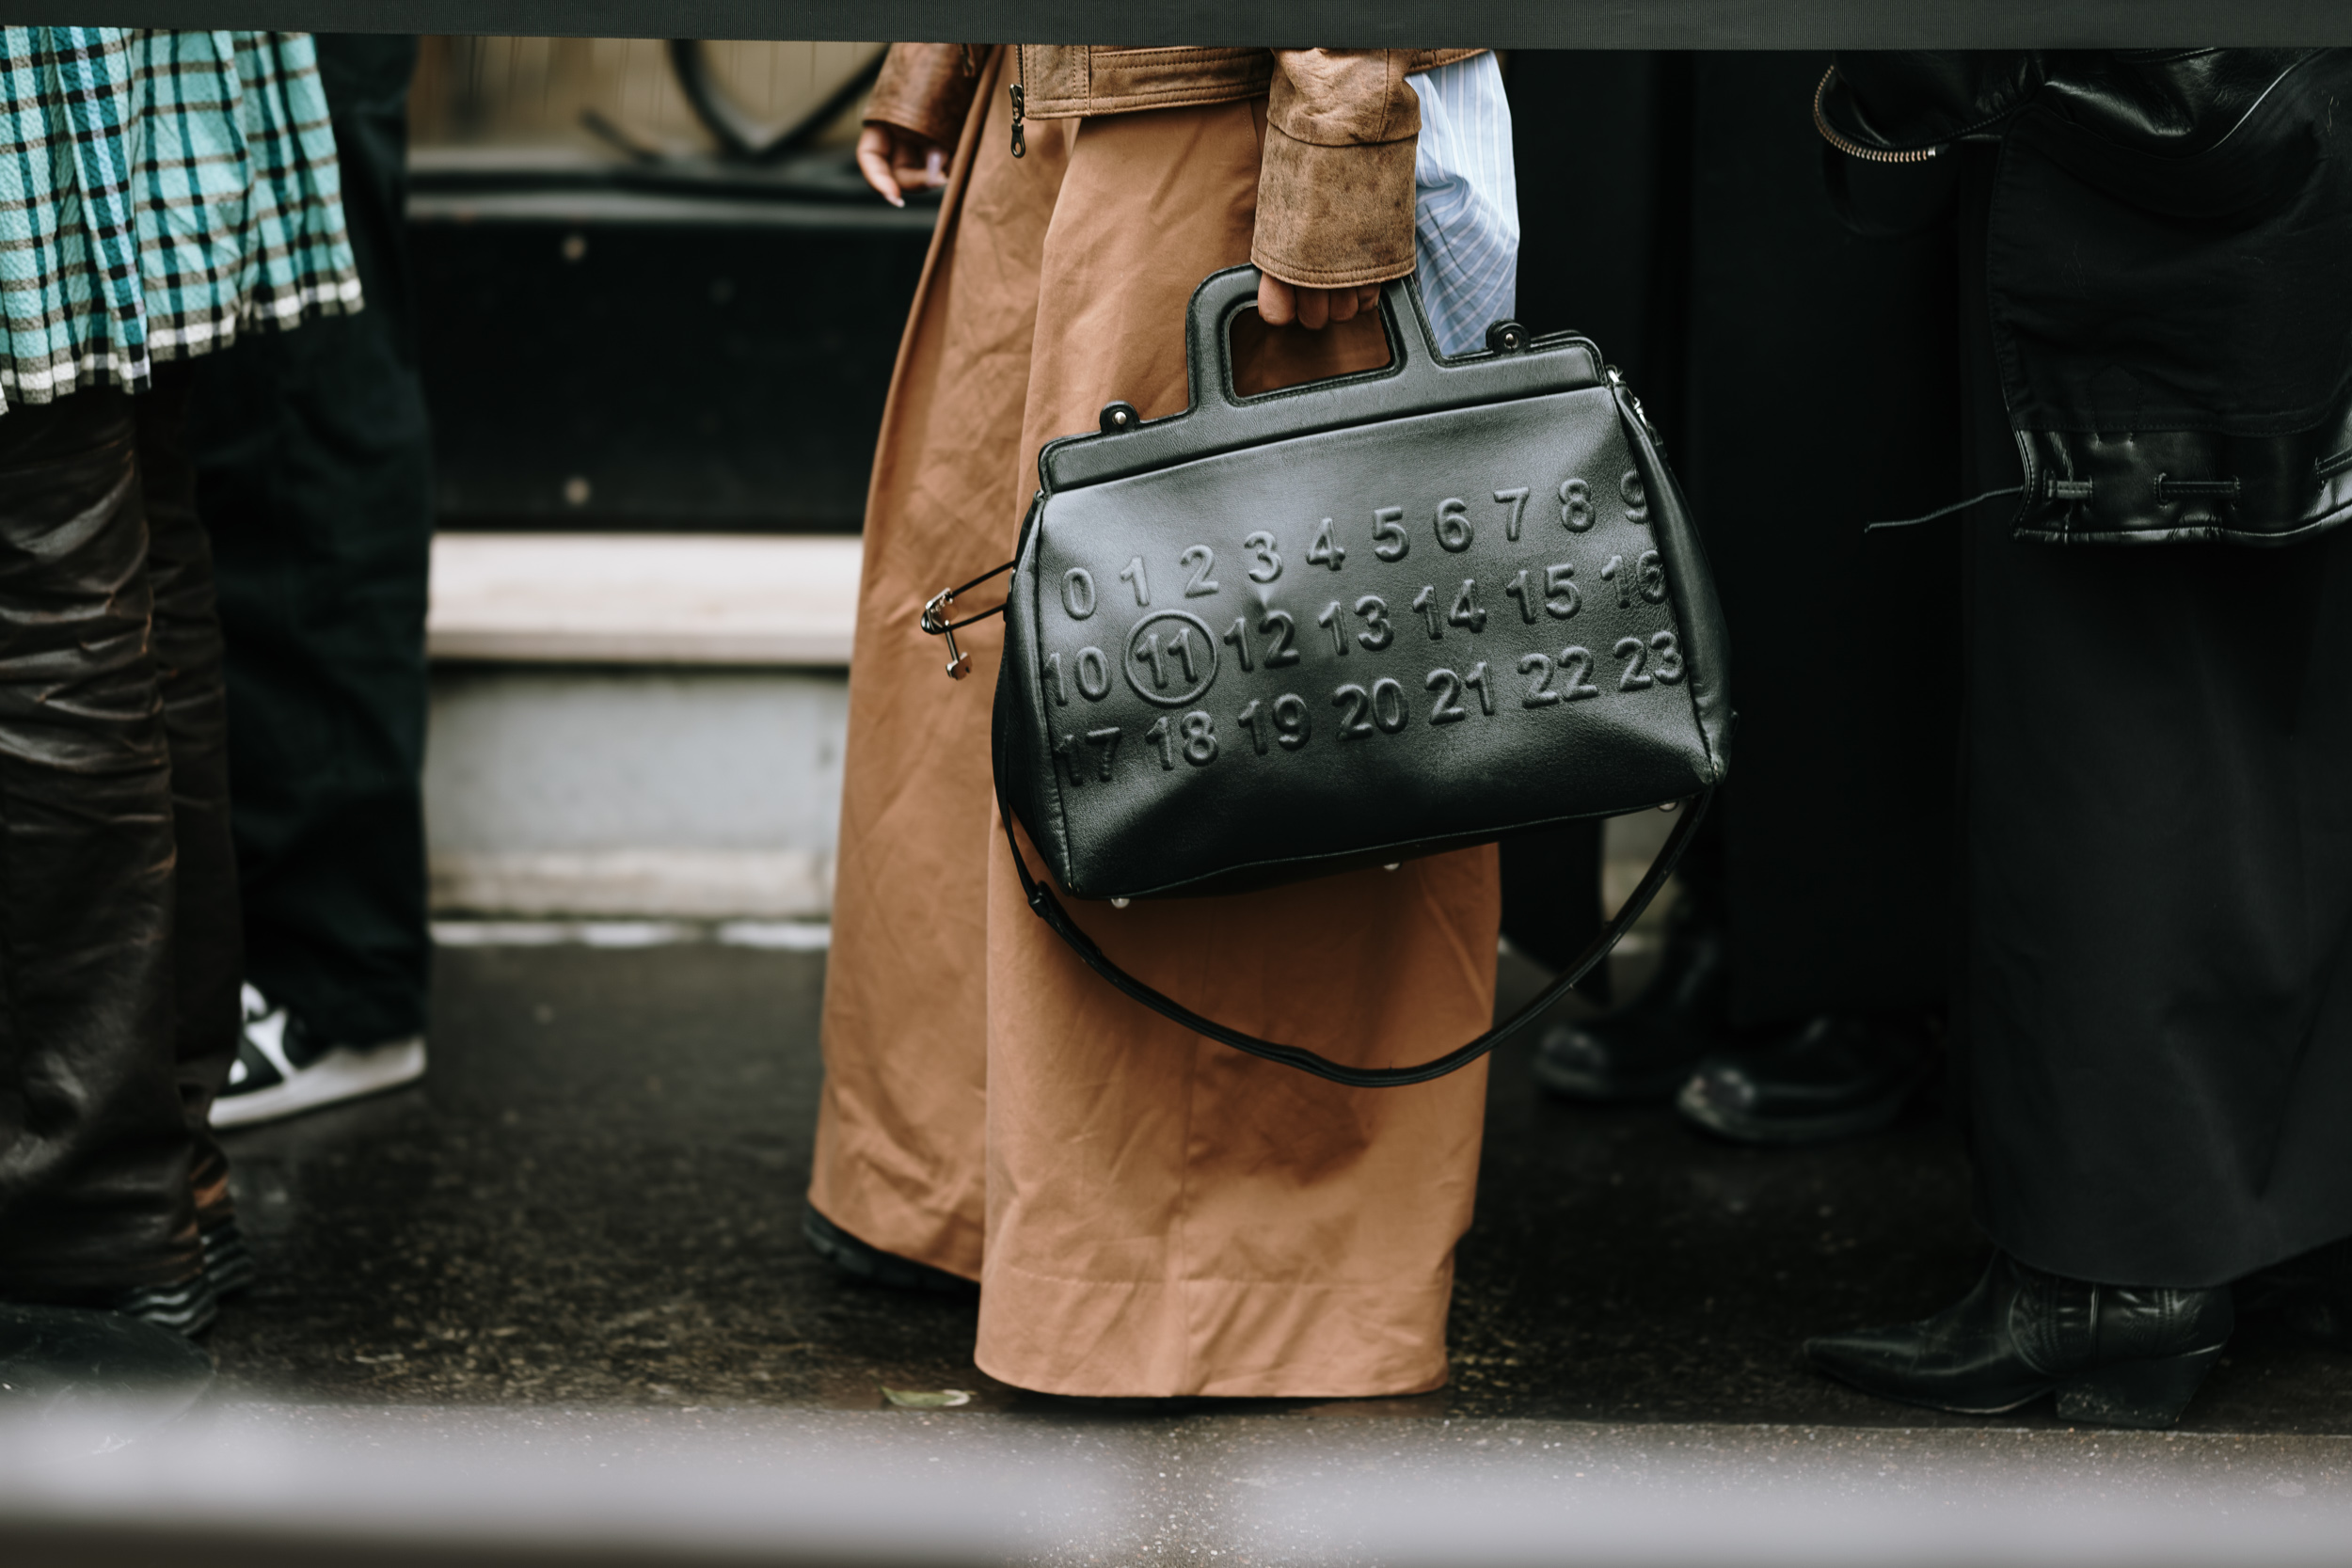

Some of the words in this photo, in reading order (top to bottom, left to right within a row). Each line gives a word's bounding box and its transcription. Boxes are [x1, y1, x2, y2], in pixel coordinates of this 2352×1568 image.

[1043, 646, 1112, 705] 10
[1136, 628, 1199, 689] 11
[1224, 610, 1300, 673] 12
[1318, 594, 1394, 656] 13
[1413, 578, 1486, 641] 14
[1506, 563, 1581, 625] 15
[1601, 549, 1668, 610] 16
[1061, 567, 1096, 620] 0
[1120, 556, 1149, 606] 1
[1181, 545, 1219, 599] 2
[1244, 531, 1282, 583] 3
[1306, 517, 1345, 571] 4
[1373, 506, 1409, 562] 5
[1434, 498, 1473, 553] 6
[1494, 486, 1530, 542] 7
[1558, 478, 1596, 533] 8
[1056, 727, 1121, 786] 17
[1145, 711, 1218, 770] 18
[1237, 692, 1311, 755] 19
[1332, 677, 1409, 741] 20
[1424, 661, 1495, 725] 21
[1517, 646, 1597, 708] 22
[1613, 630, 1687, 691] 23
